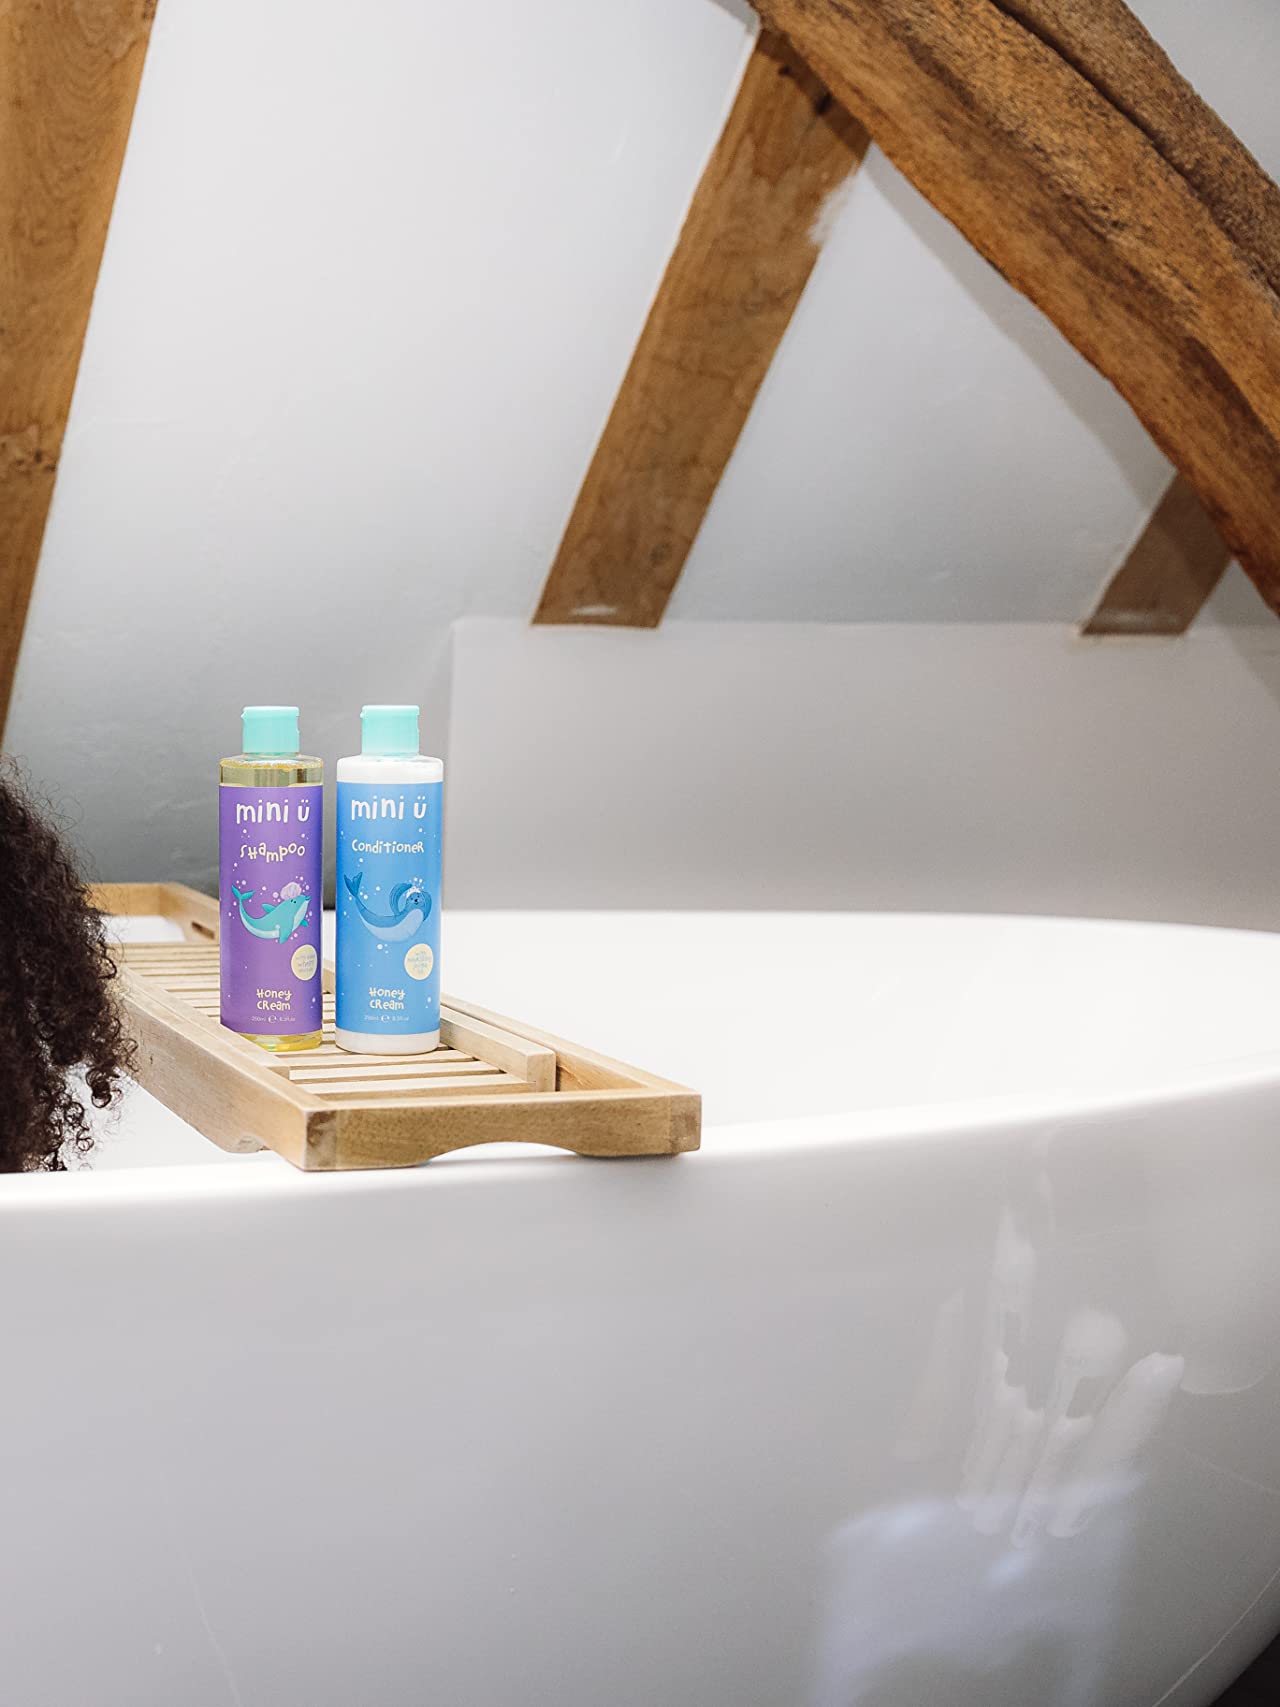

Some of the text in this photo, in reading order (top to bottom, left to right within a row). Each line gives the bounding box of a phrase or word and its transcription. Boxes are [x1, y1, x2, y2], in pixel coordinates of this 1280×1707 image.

[236, 799, 311, 824] mini ü
[351, 795, 427, 820] mini ü
[256, 988, 292, 1001] Honey
[369, 987, 405, 1000] Honey
